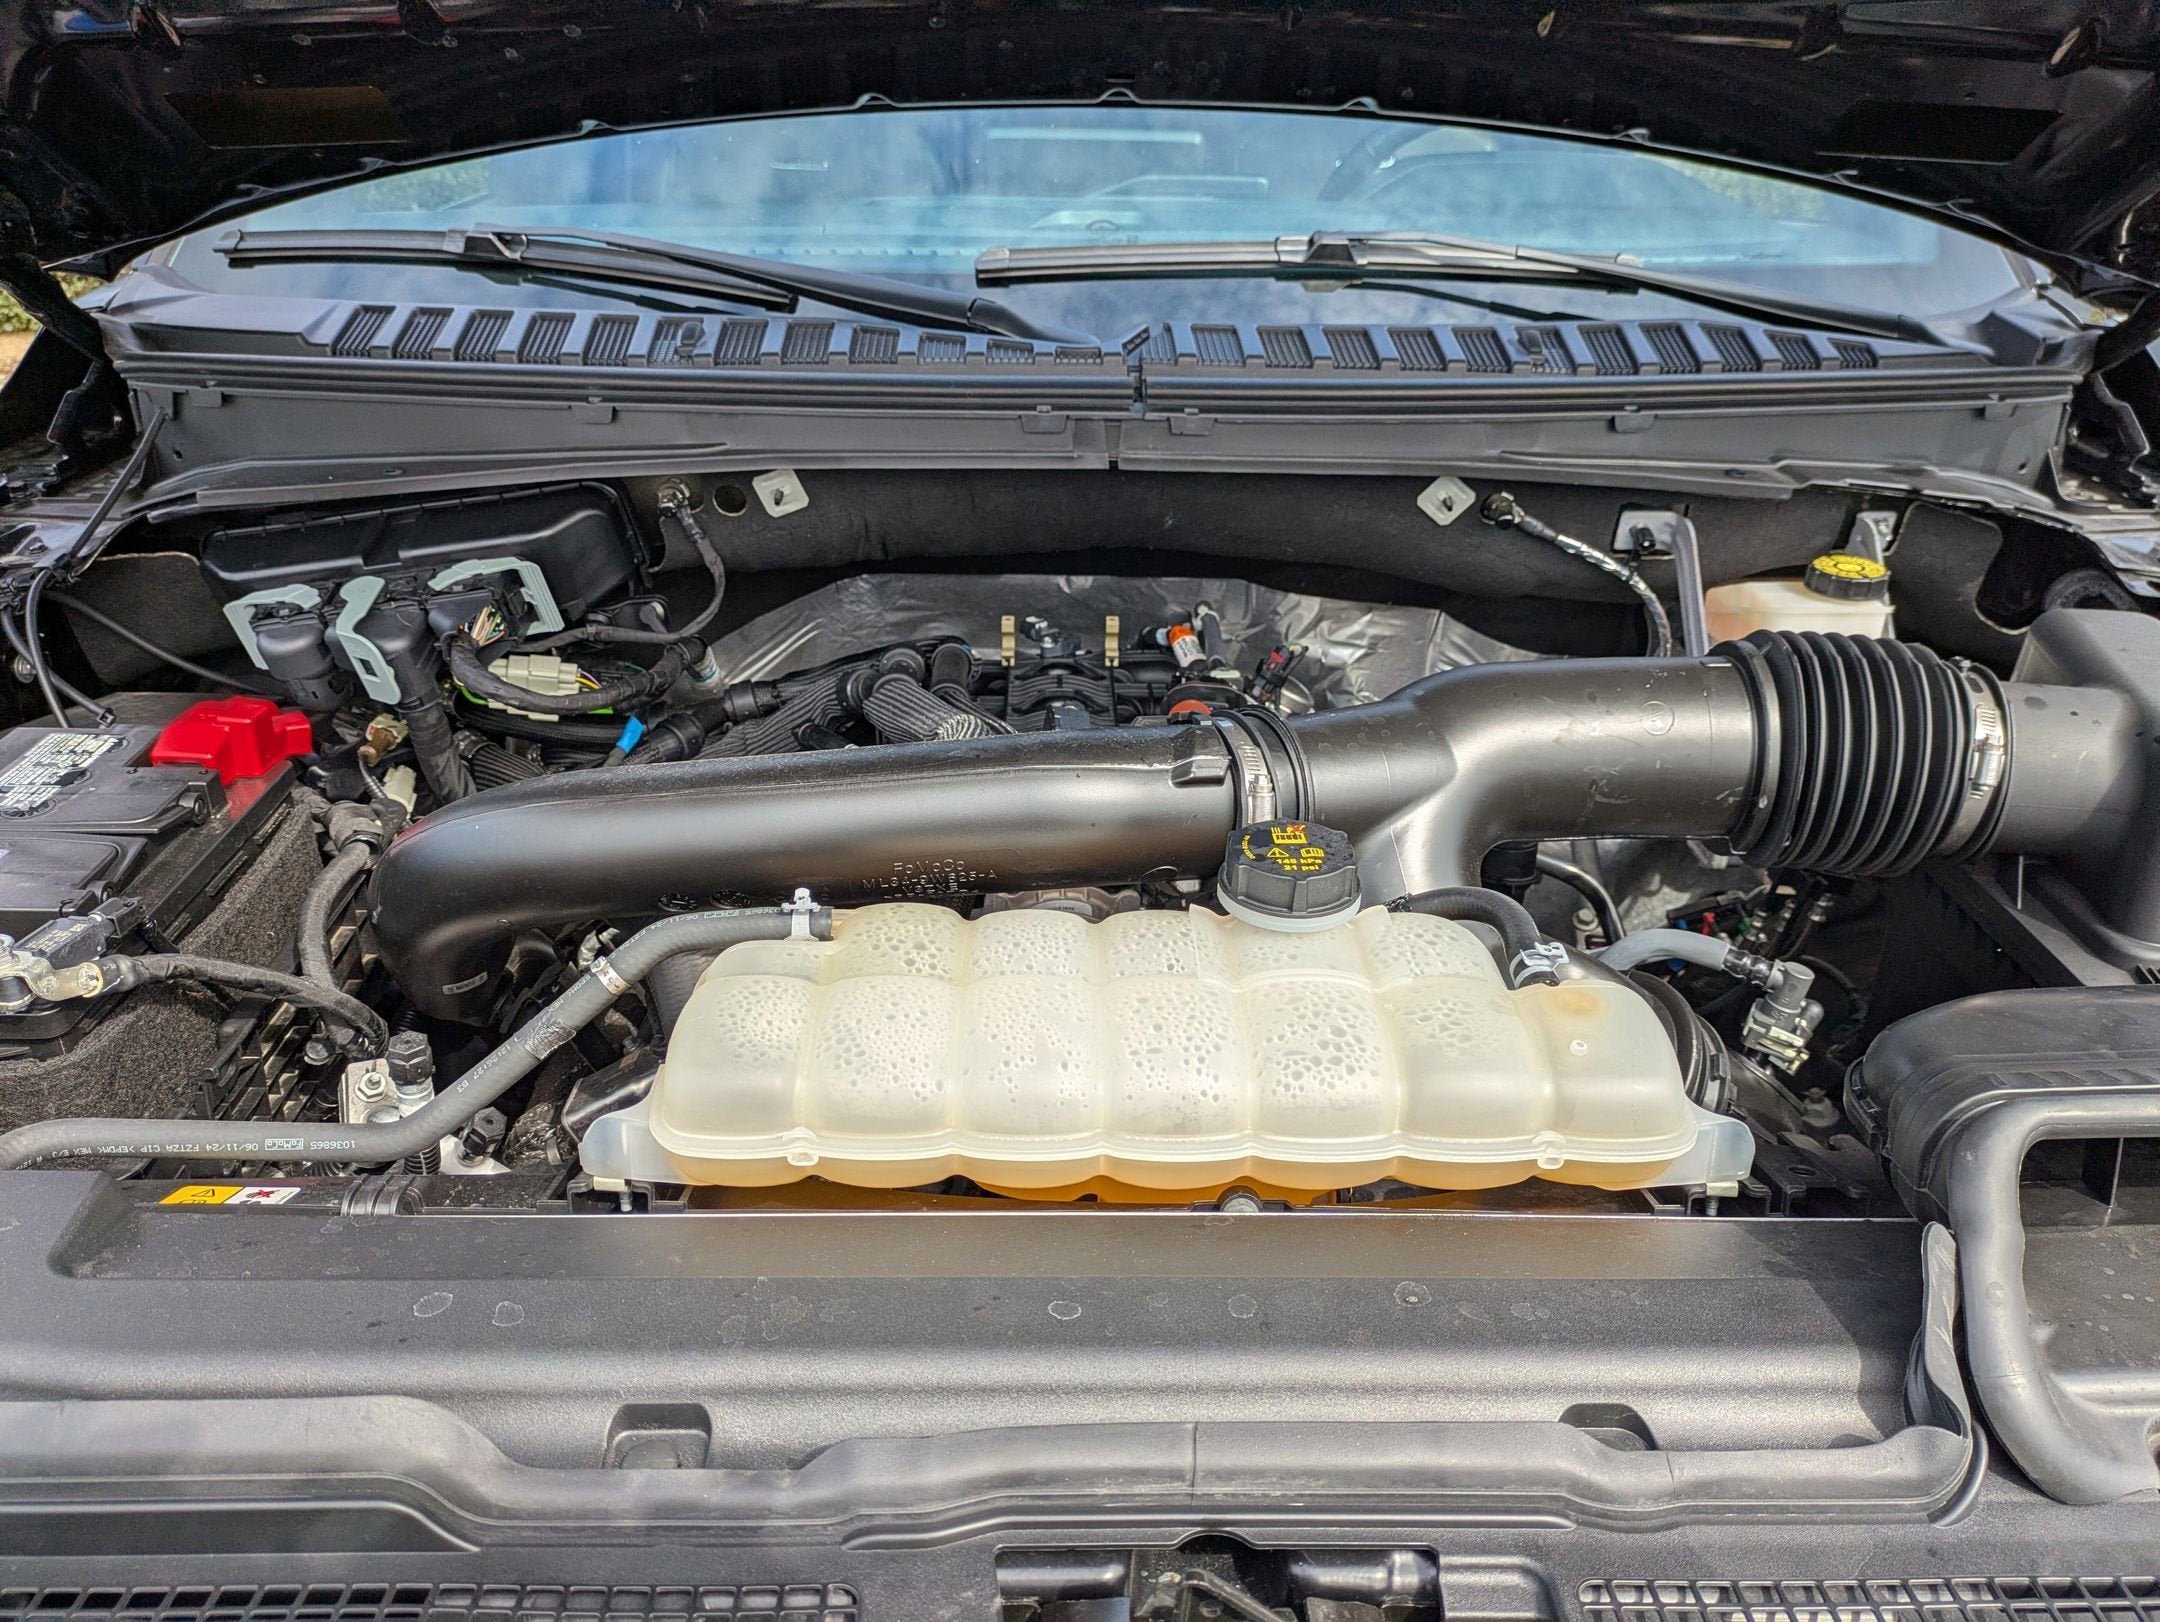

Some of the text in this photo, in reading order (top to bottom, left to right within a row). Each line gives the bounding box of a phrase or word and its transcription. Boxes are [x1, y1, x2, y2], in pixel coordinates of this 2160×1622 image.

[893, 858, 965, 874] FoMoCo
[141, 1144, 160, 1153] CIP
[205, 1142, 258, 1151] 06/11/24
[266, 1139, 303, 1150] FoMoCo
[310, 1140, 356, 1150] 1036865
[73, 1146, 92, 1156] MEX
